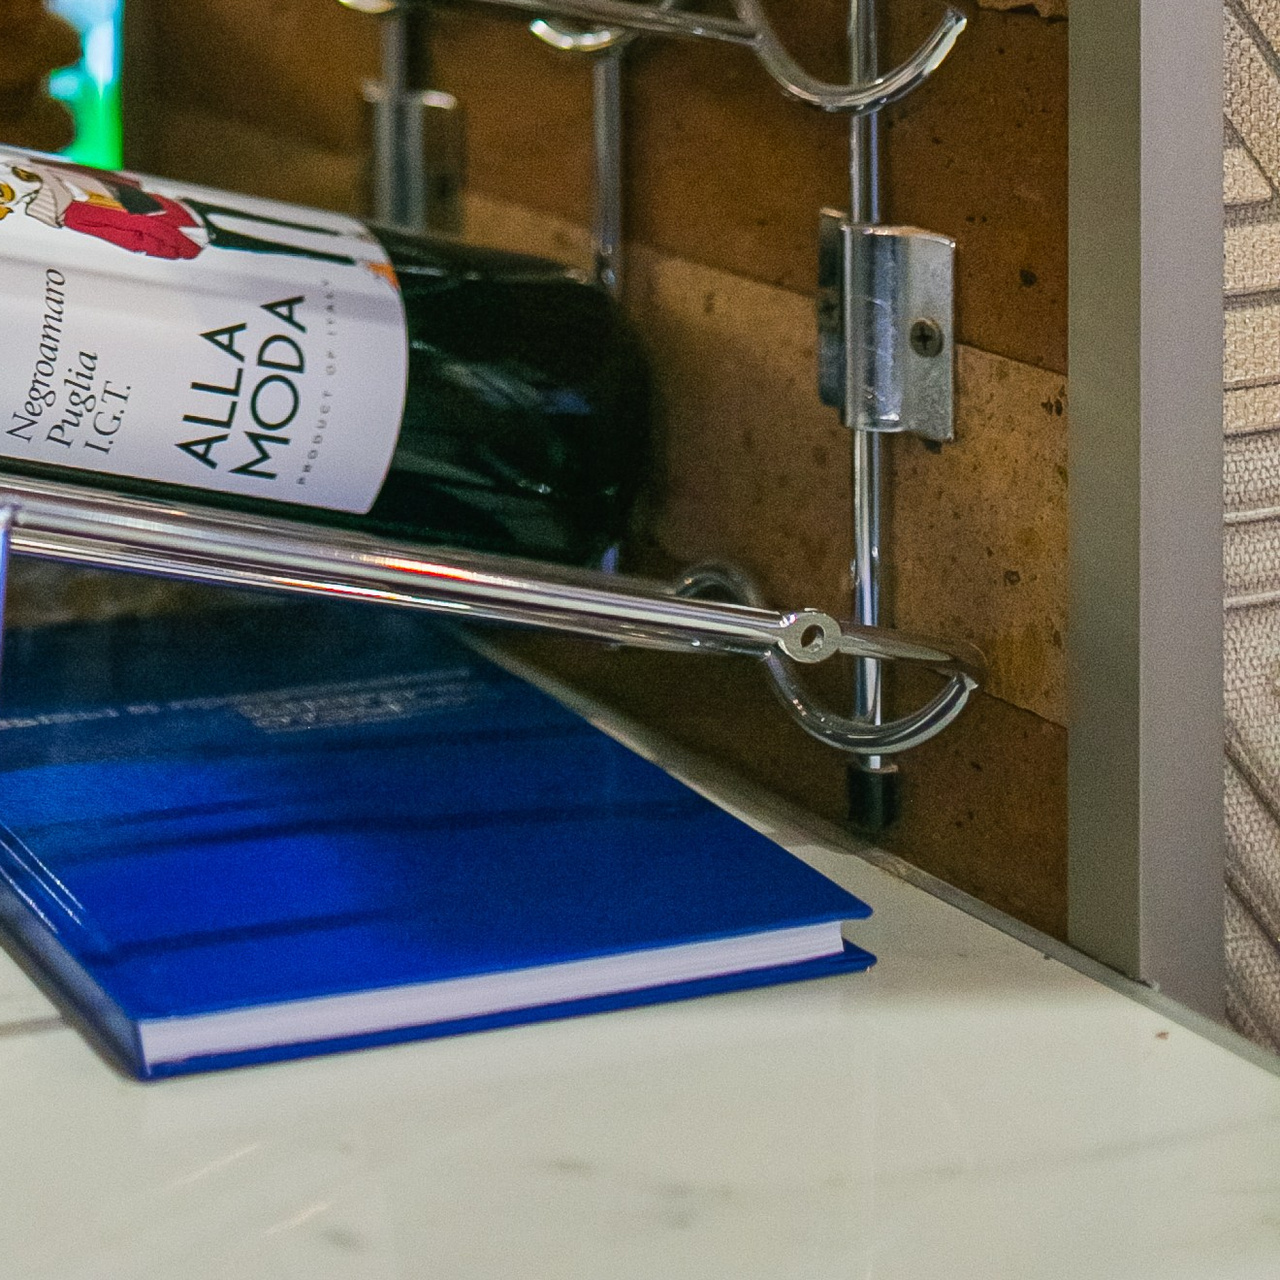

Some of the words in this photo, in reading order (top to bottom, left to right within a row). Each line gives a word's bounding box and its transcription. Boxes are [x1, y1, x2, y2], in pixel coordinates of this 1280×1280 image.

[6, 268, 66, 443] Negroamaro
[45, 350, 99, 449] Puglia
[83, 383, 132, 455] I.G.T.
[175, 322, 248, 469] ALLA
[228, 295, 306, 480] MODA
[296, 391, 333, 485] PRODUCT
[324, 349, 336, 375] OF
